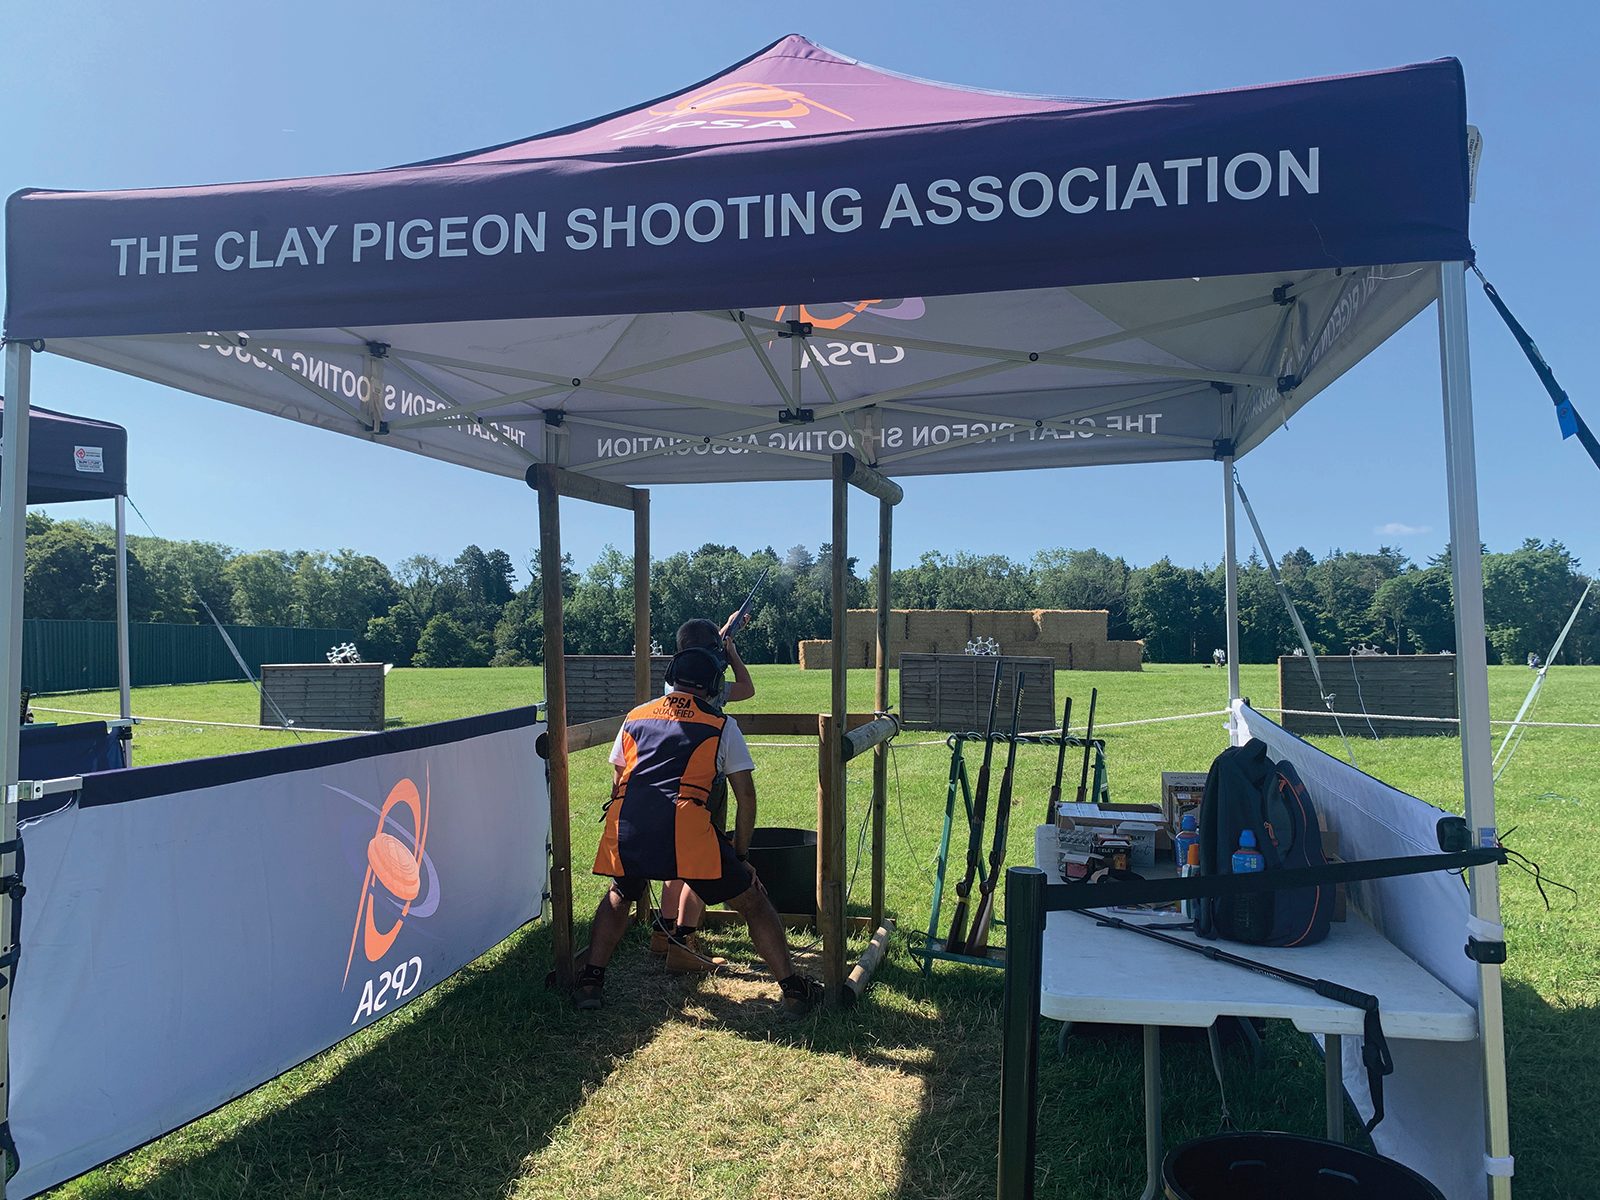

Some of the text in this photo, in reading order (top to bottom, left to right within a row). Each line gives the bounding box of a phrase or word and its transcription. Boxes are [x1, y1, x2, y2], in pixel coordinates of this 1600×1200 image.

[111, 147, 1319, 276] THE CLAY PIGEON SHOOTING ASSOCIATION
[662, 697, 691, 709] CPSA
[653, 708, 695, 719] QUALIFIED
